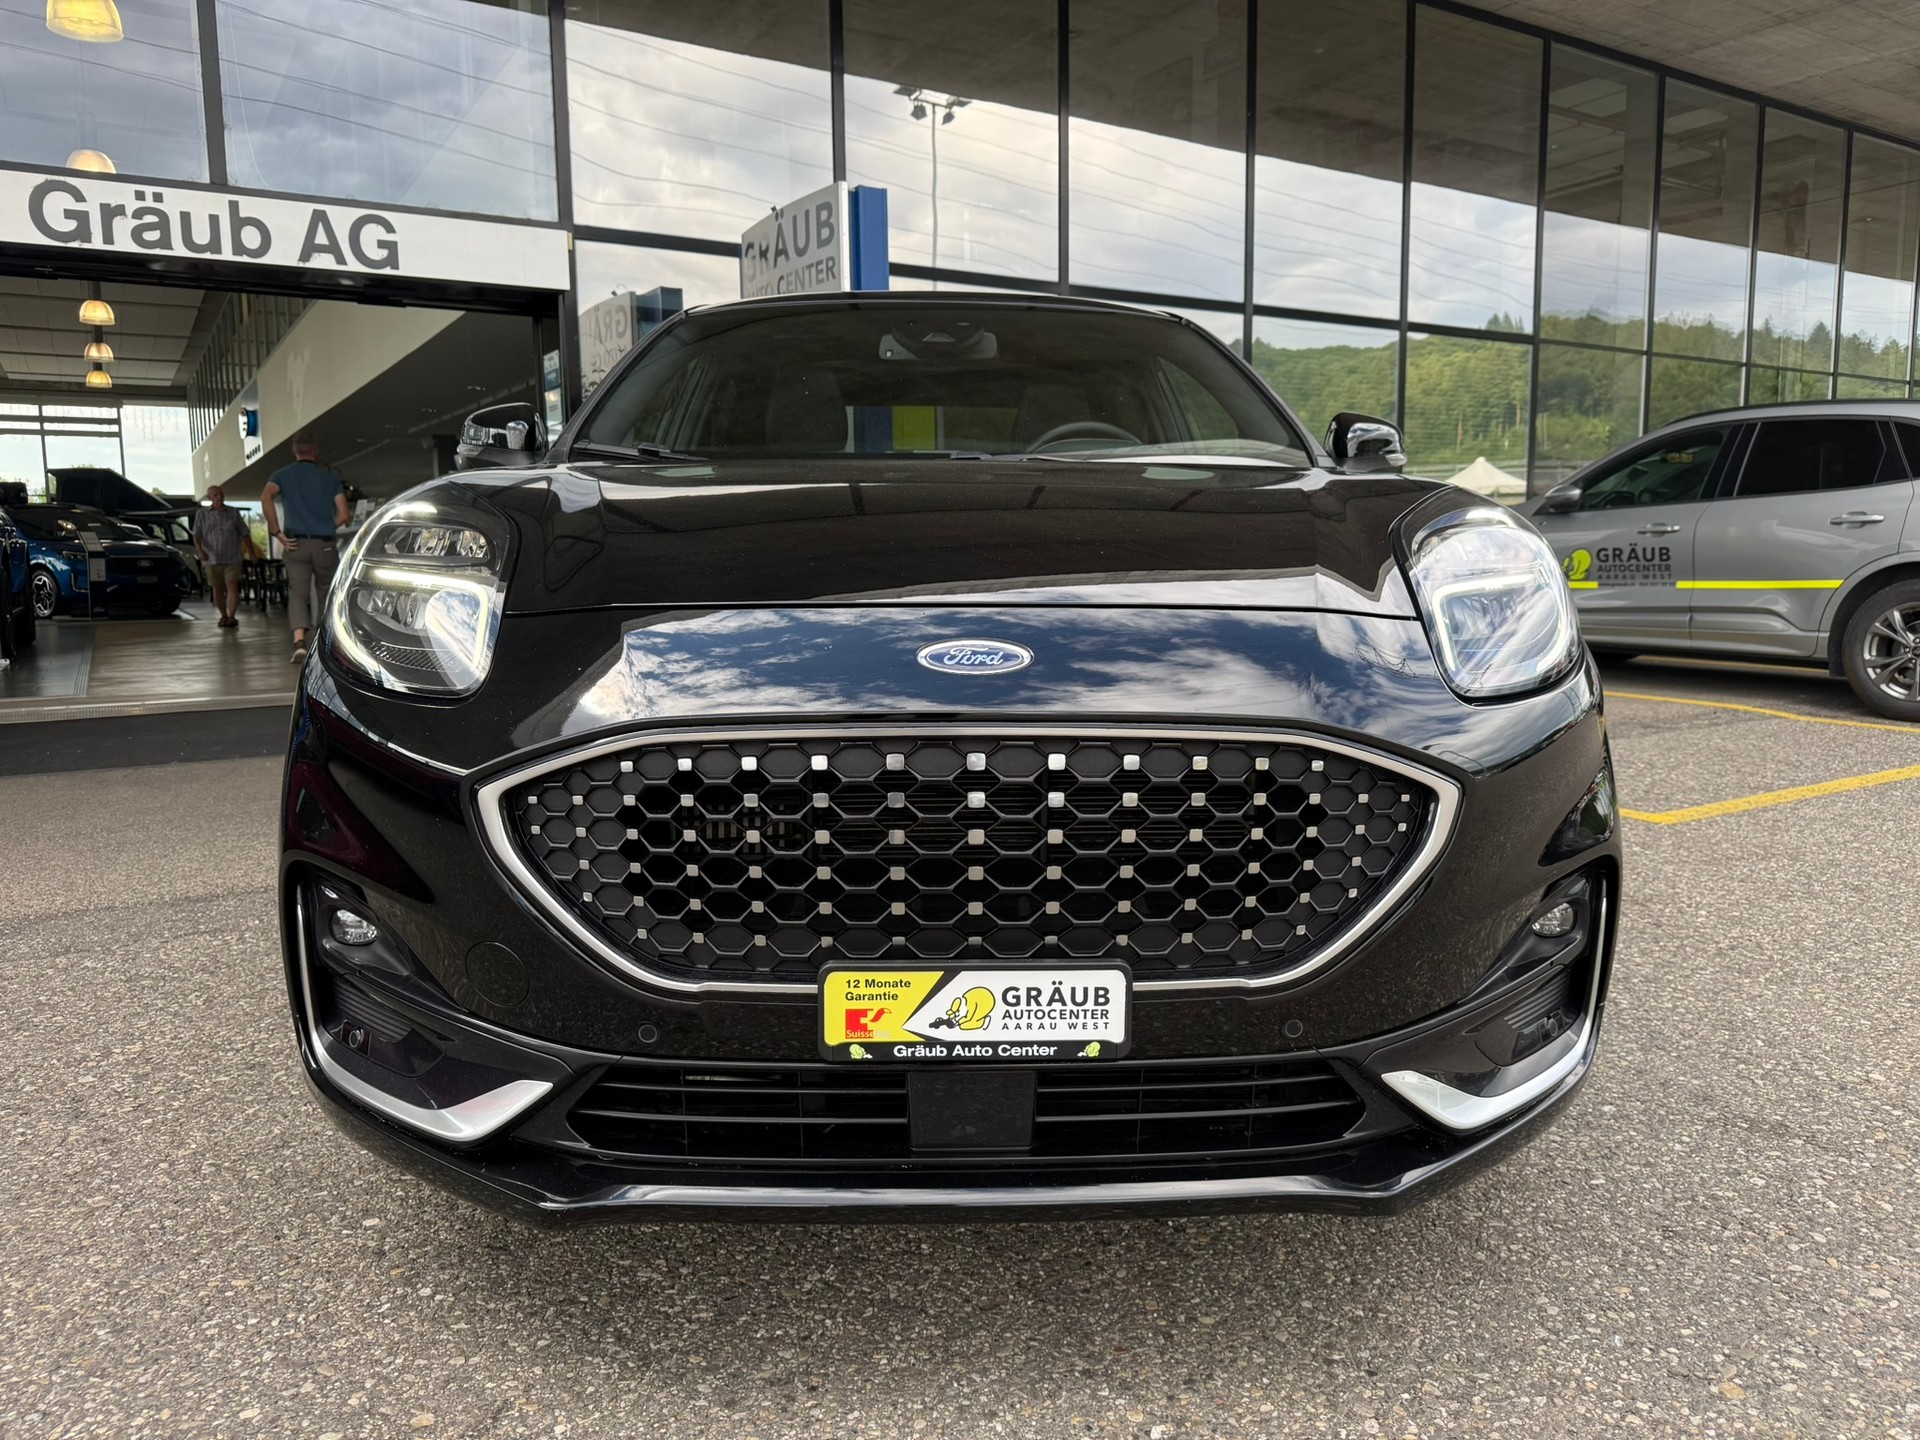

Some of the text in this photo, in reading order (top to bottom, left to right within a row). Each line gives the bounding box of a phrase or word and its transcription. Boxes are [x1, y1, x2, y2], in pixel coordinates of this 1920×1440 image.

[28, 179, 400, 271] Gräub AG
[744, 200, 835, 284] GRÄUB
[777, 255, 837, 295] CENTER
[1596, 542, 1671, 563] GRÄUB
[1597, 563, 1672, 573] AUTOCENTER
[943, 646, 1004, 665] Ford
[846, 978, 911, 989] 12 Monate
[845, 991, 899, 1001] Garantie
[1001, 980, 1111, 1008] GRÄUB
[1001, 1009, 1110, 1021] AUTOCENTER
[1001, 1021, 1110, 1031] AARAU WEST
[893, 1044, 1058, 1058] Gräub Auto Center
